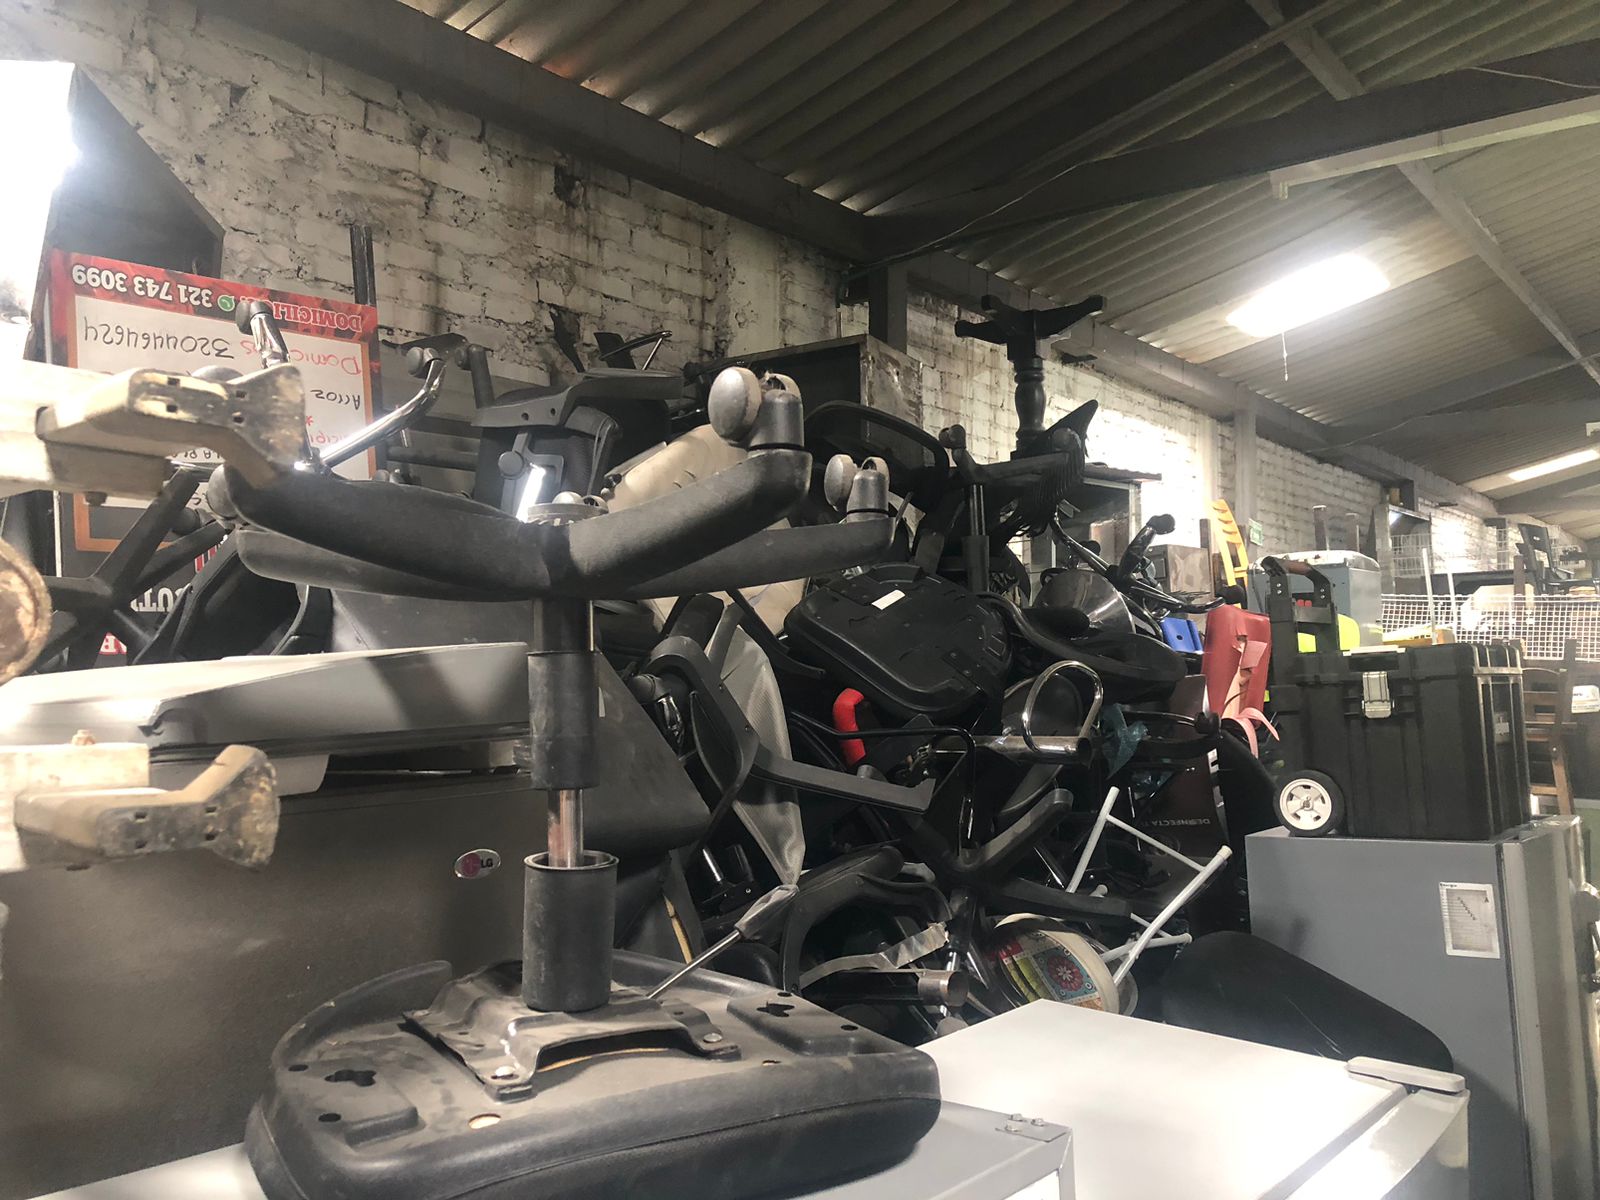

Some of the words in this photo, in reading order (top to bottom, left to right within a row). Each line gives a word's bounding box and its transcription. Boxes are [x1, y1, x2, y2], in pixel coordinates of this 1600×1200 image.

[72, 264, 128, 293] 3099
[132, 275, 173, 301] 743
[177, 284, 213, 308] 321
[481, 859, 493, 868] LG
